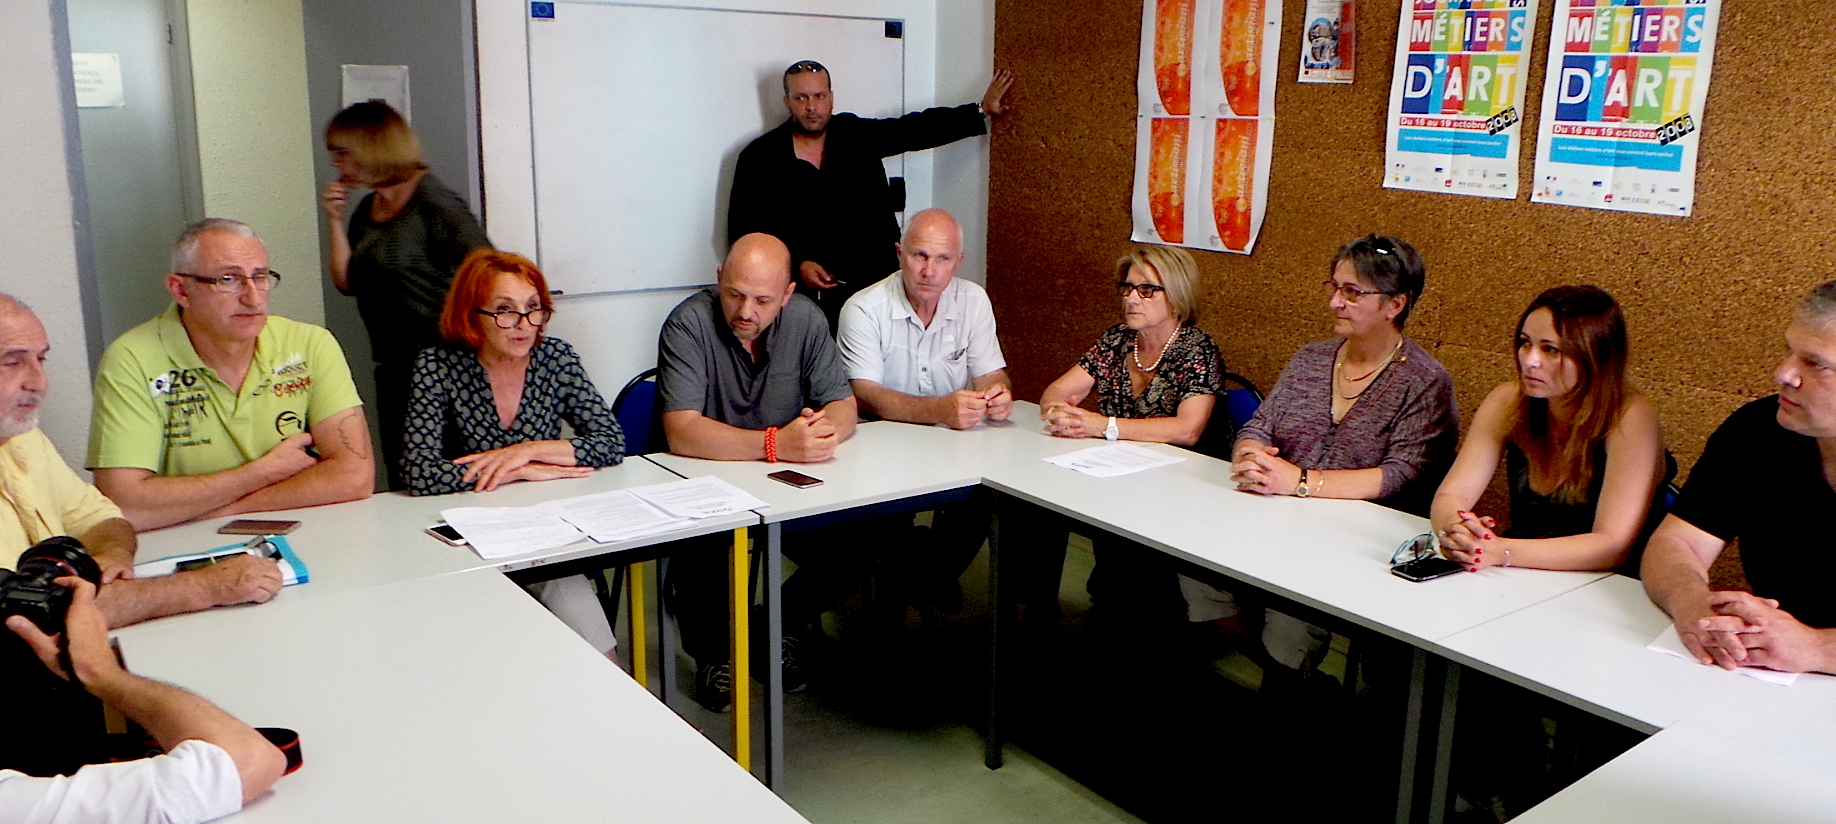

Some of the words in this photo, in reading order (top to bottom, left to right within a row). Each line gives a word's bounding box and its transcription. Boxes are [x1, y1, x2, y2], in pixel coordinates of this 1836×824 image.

[1410, 11, 1525, 43] MÉTIERS
[1566, 9, 1705, 43] MÉTIERS
[1404, 58, 1518, 105] D'ART
[1559, 60, 1694, 113] D'ART
[1400, 117, 1413, 125] Du
[1415, 118, 1425, 126] 16
[1426, 119, 1438, 127] au
[1440, 119, 1451, 127] 19
[1453, 120, 1486, 130] octobre
[1554, 125, 1568, 134] Du
[1571, 126, 1582, 135] 16
[1584, 127, 1597, 135] au
[1601, 127, 1613, 137] 19
[1616, 128, 1656, 139] octobre
